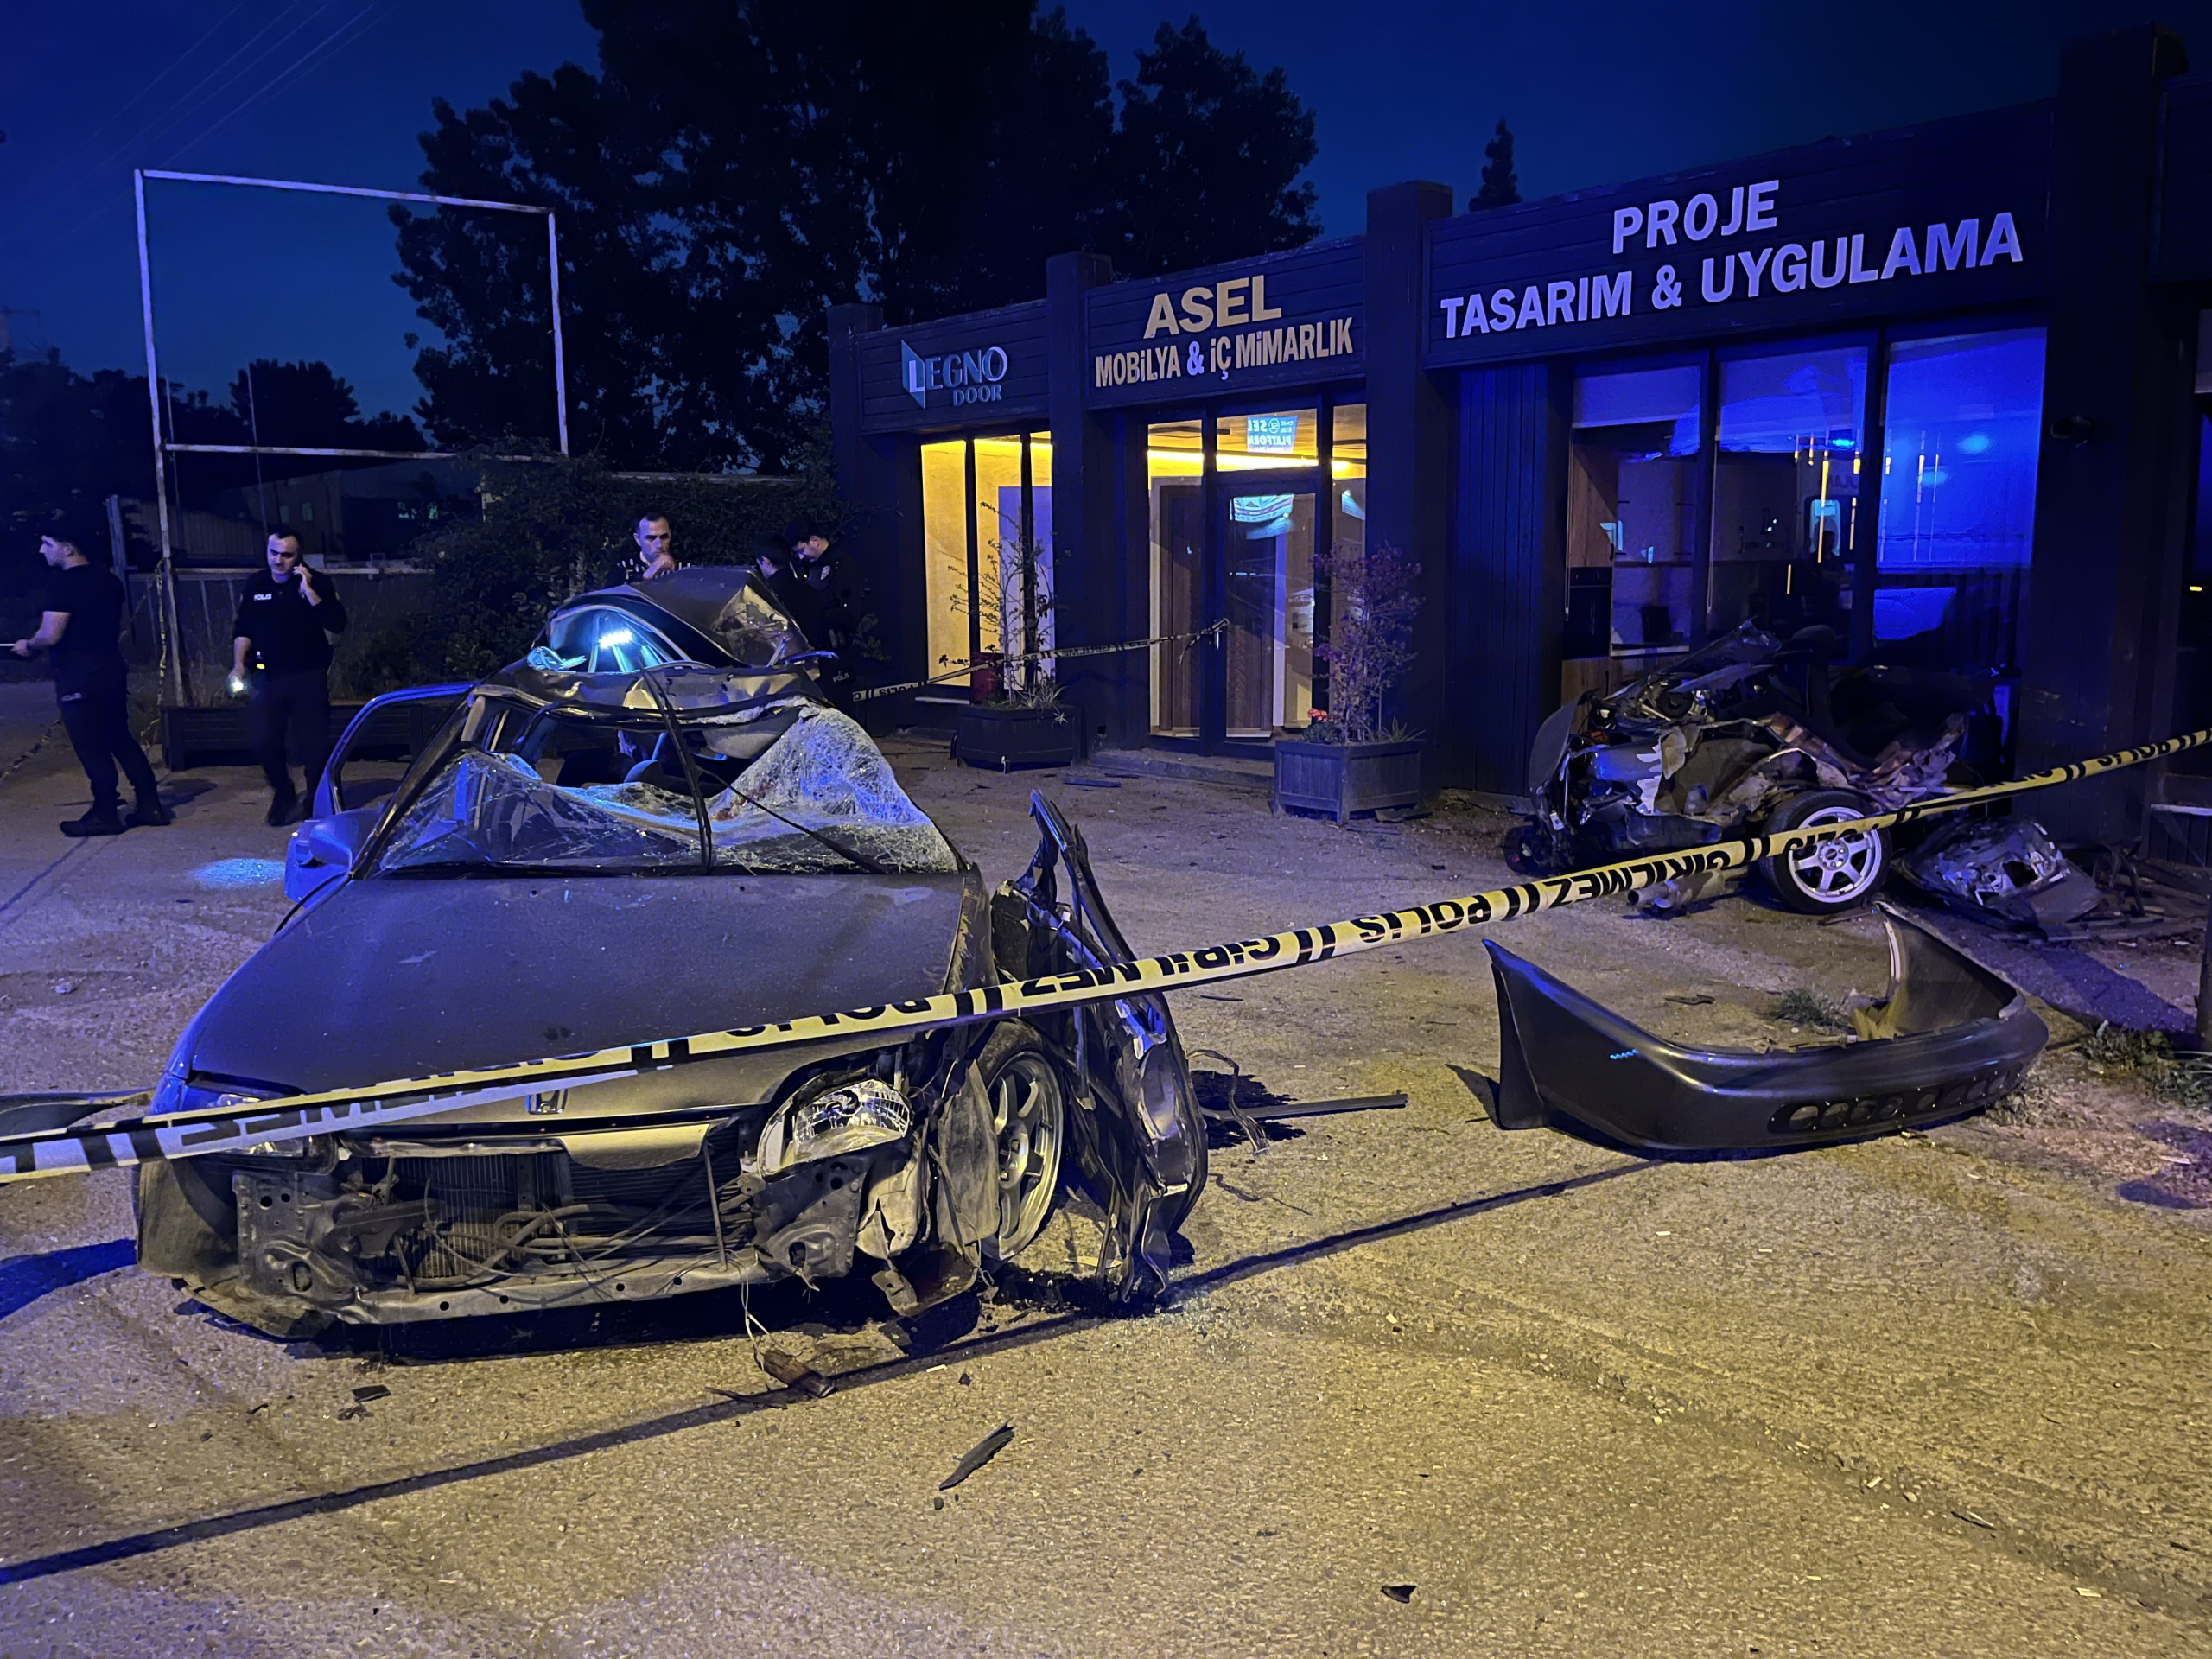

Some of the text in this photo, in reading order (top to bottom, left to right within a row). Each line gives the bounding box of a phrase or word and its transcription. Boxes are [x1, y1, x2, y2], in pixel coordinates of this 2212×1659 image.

[1612, 179, 1780, 254] PROJE
[1440, 212, 2024, 339] TASARIM & UYGULAMA
[1142, 274, 1282, 340] ASEL
[908, 346, 1008, 393] LEGNO
[1186, 340, 1205, 376] &
[953, 384, 1002, 407] DOOR
